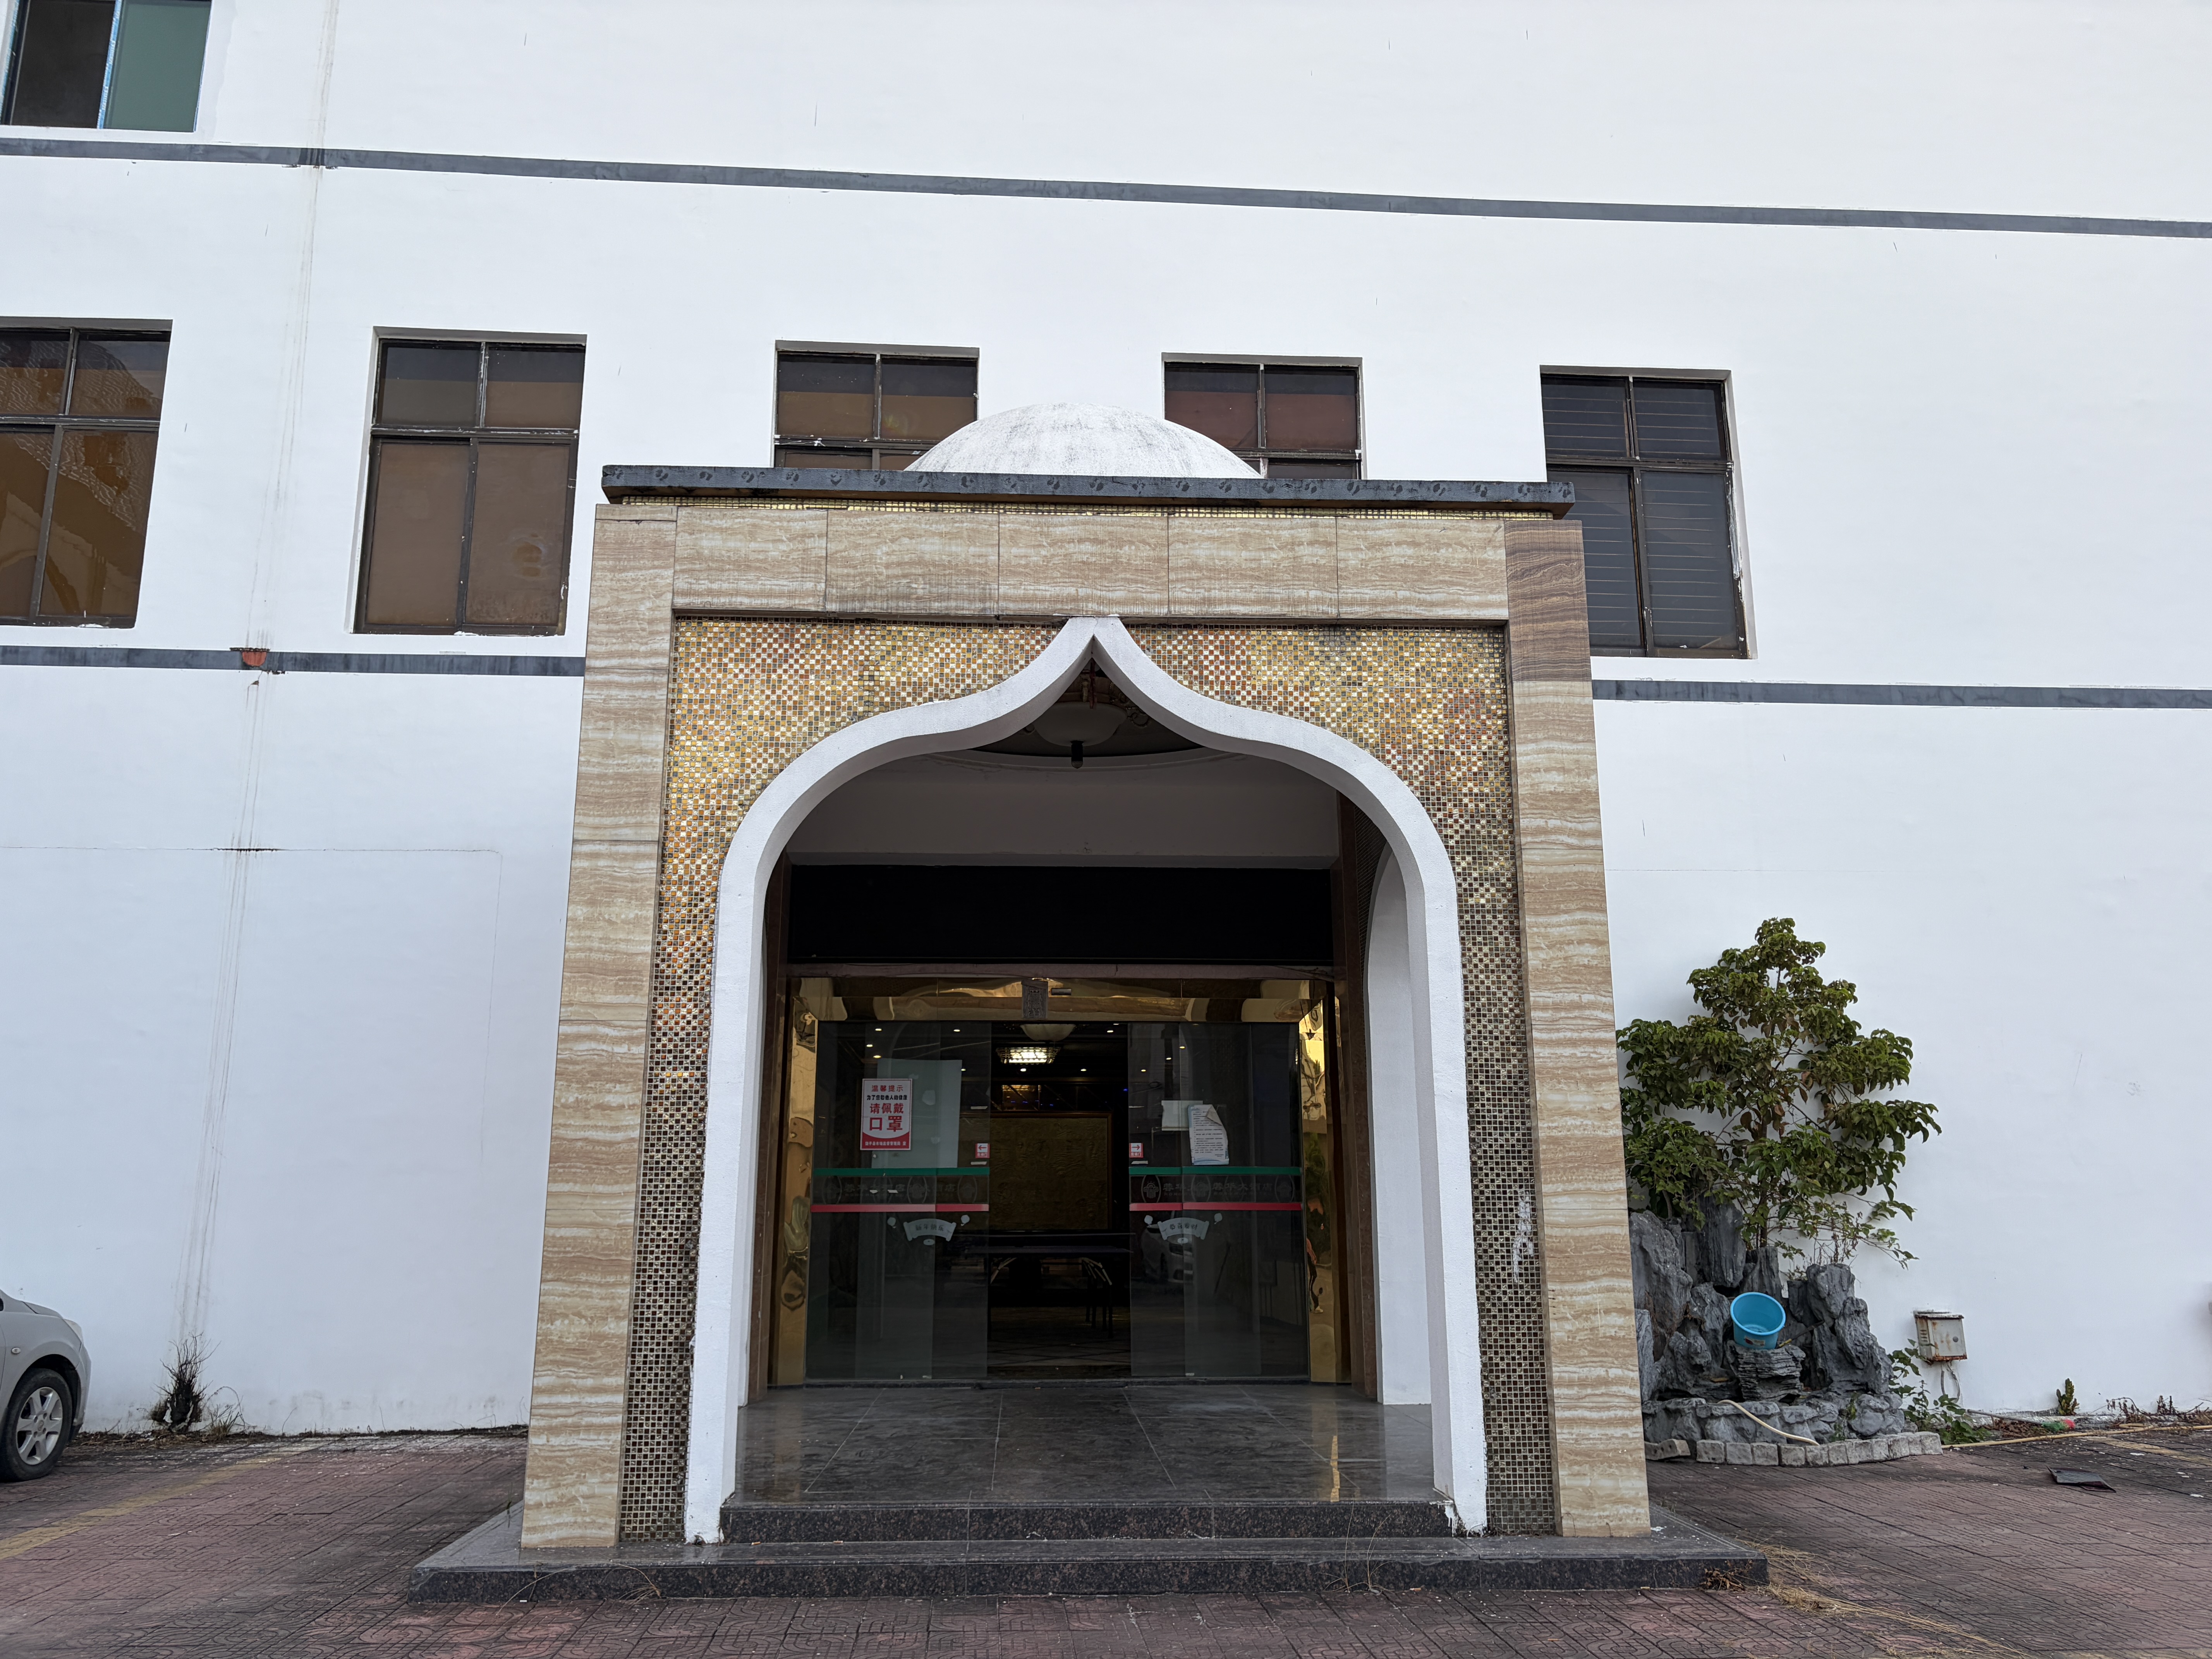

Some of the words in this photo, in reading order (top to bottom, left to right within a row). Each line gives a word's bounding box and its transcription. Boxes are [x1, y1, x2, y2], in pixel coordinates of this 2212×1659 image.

[869, 1103, 904, 1114] 请佩戴
[869, 1116, 903, 1132] 口罩
